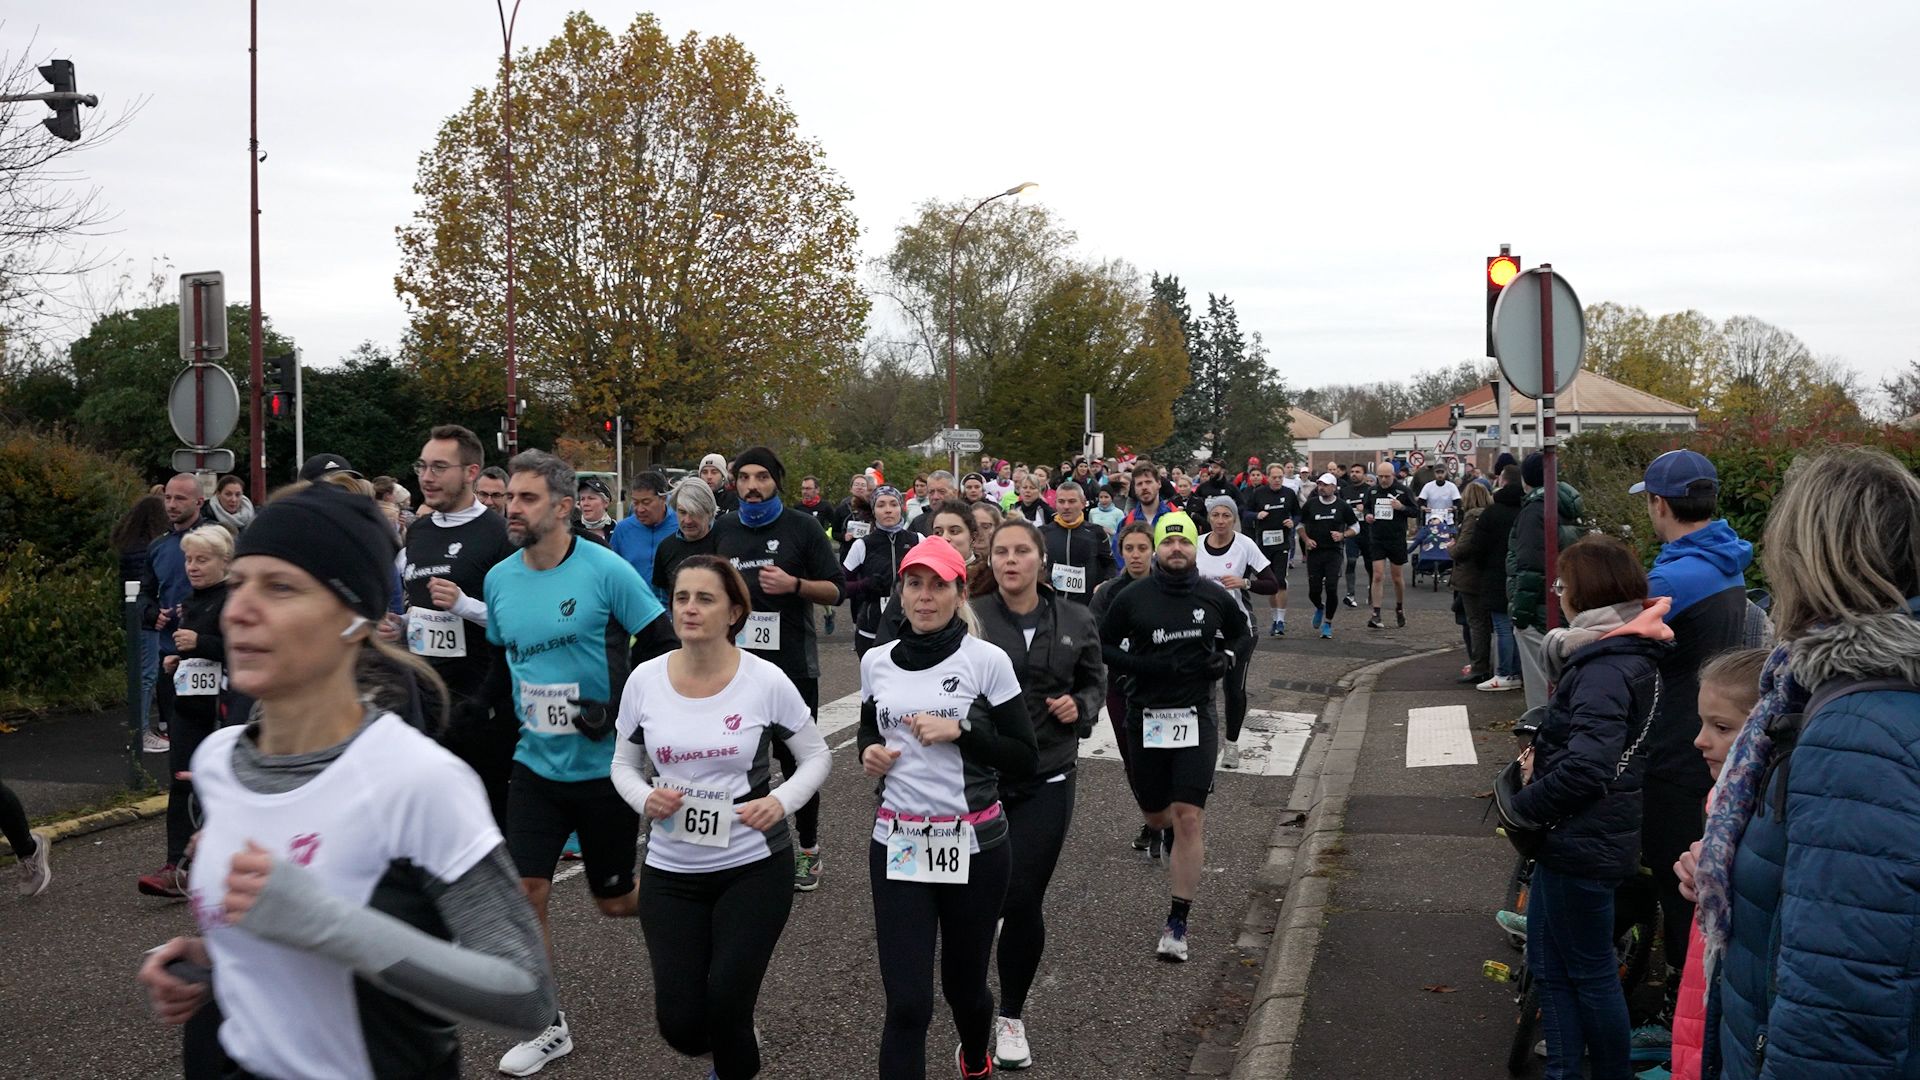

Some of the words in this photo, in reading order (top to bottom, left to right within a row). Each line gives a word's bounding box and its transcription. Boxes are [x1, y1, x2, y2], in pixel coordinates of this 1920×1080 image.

[1066, 576, 1083, 588] 800
[428, 629, 456, 649] 729
[755, 626, 770, 643] 28
[1165, 628, 1203, 642] MARLIENNE
[191, 673, 216, 689] 963
[1173, 724, 1188, 741] 27
[674, 746, 740, 763] MARLIENNE
[684, 807, 719, 836] 651
[926, 847, 959, 873] 148
